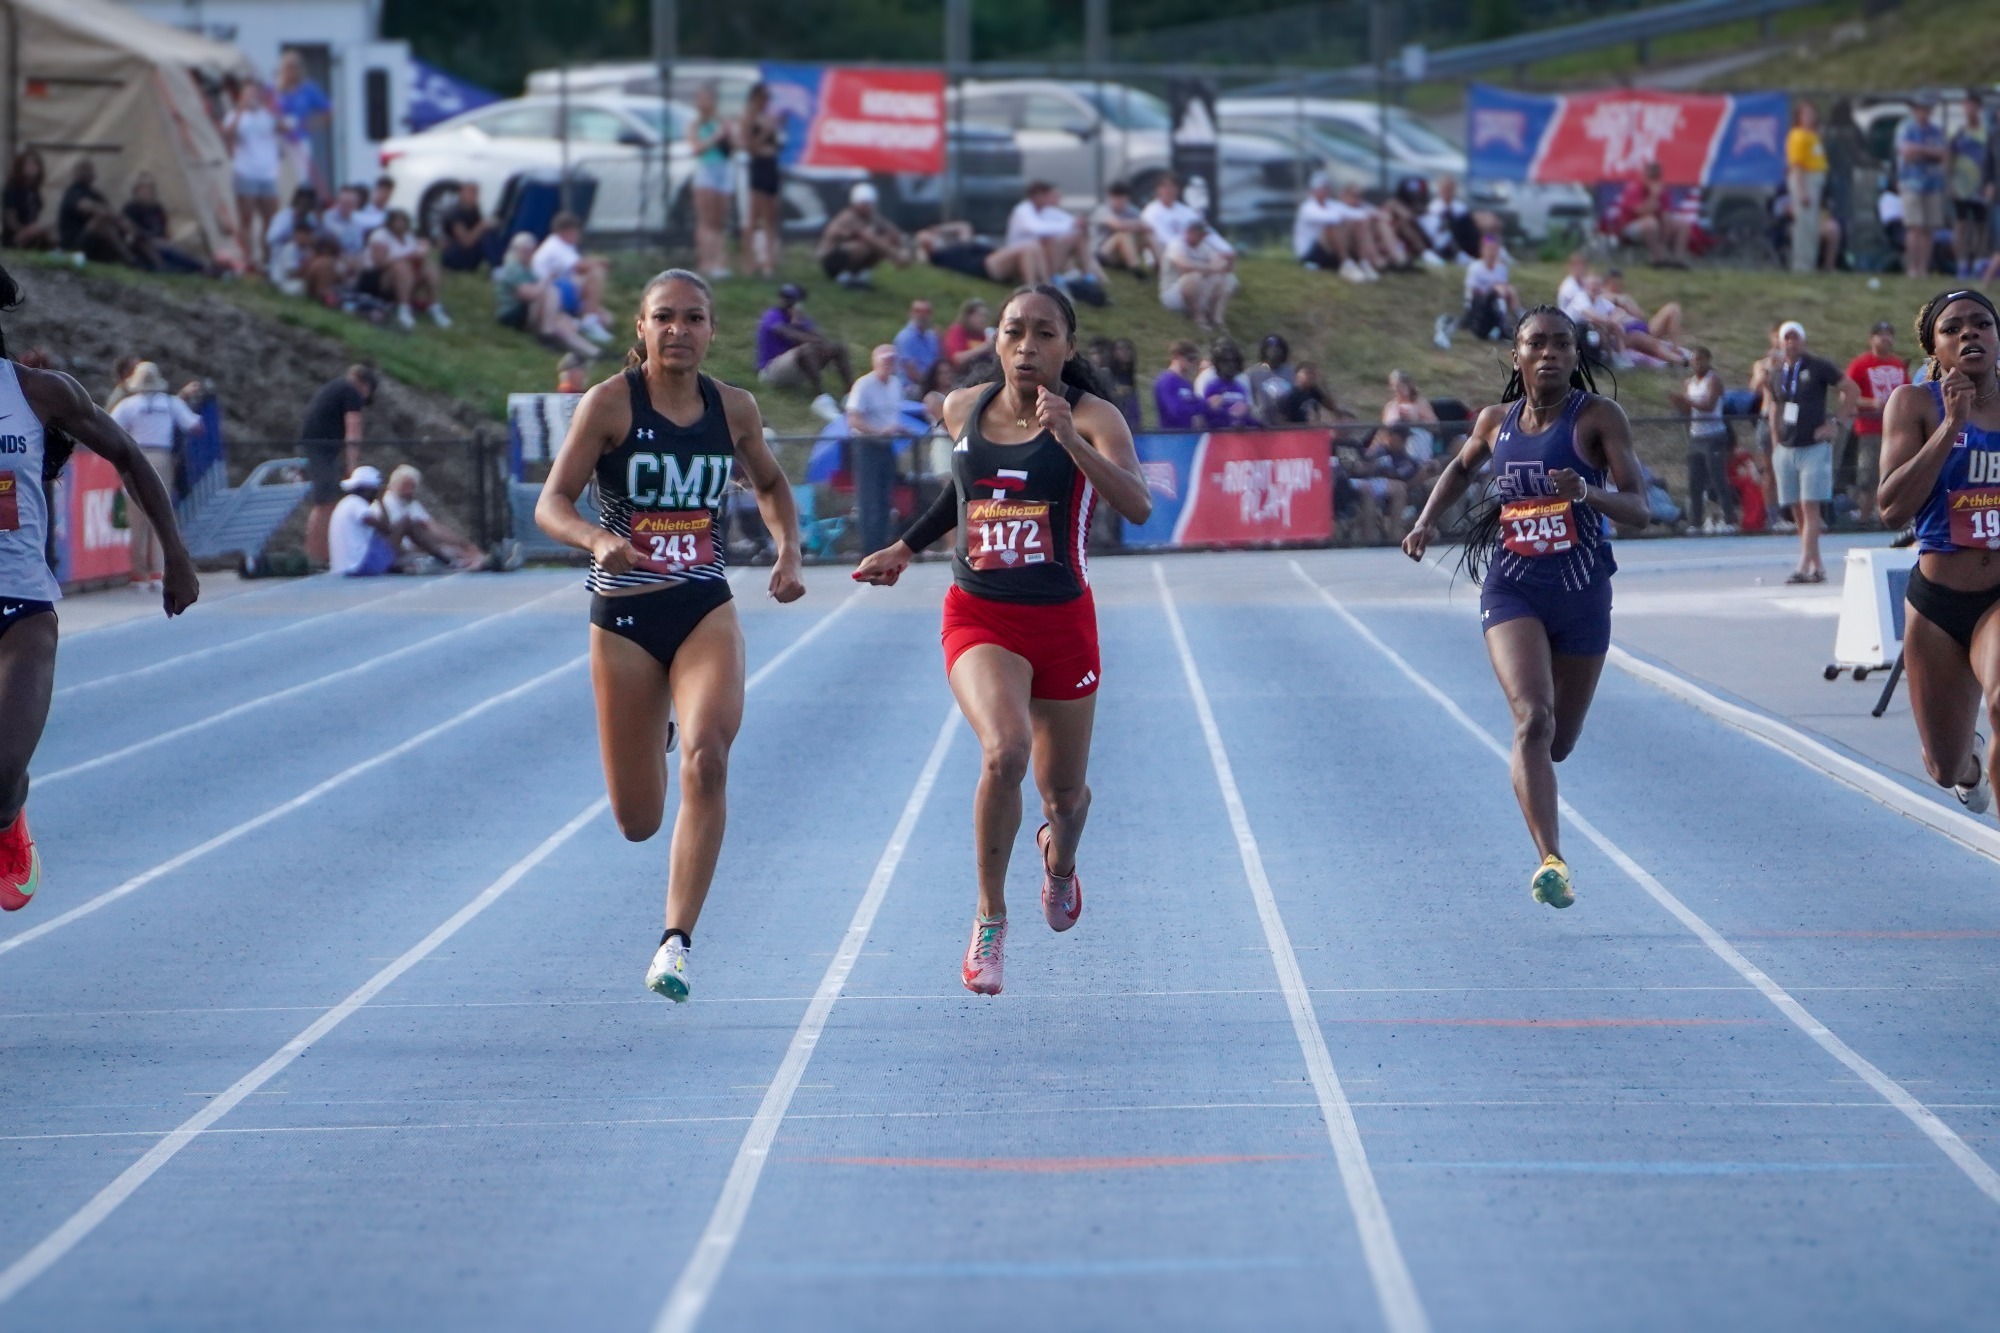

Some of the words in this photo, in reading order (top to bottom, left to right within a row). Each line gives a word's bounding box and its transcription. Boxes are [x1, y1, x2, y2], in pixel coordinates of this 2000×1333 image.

[627, 452, 733, 508] CMU
[979, 520, 1041, 552] 1172
[1512, 515, 1567, 542] 1245
[1971, 510, 2000, 538] 19
[650, 534, 698, 561] 243
